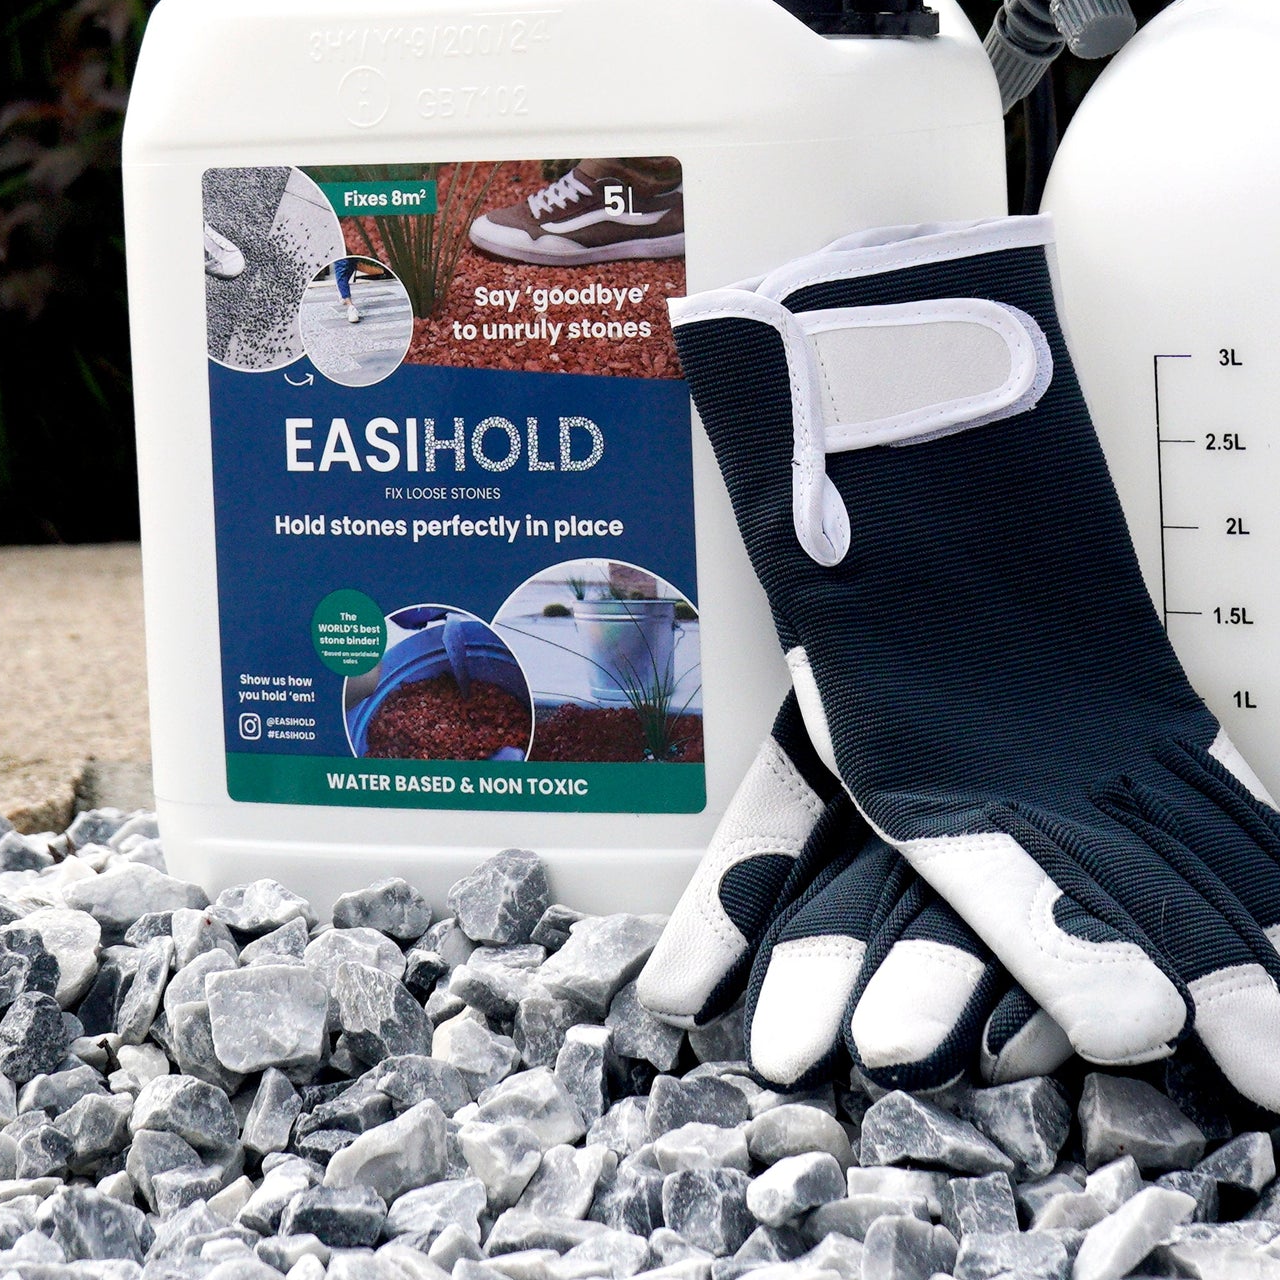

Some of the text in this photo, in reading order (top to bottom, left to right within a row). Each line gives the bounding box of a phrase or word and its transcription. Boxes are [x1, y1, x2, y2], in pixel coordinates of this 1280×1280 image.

[417, 85, 455, 118] GB
[344, 191, 388, 208] Fixes
[604, 185, 642, 217] 5L
[475, 286, 520, 312] Say
[452, 318, 652, 346] to unruly stones
[1219, 348, 1243, 366] 3L
[285, 416, 605, 473] EASIHOLD
[1205, 432, 1247, 452] 2.5L
[385, 487, 501, 500] FIX LOOSE STONES
[275, 514, 624, 543] Hold stones perfectly in place
[1226, 517, 1250, 535] 2L
[340, 612, 357, 621] The
[1213, 607, 1255, 626] 1.5L
[360, 624, 380, 634] best
[320, 636, 380, 646] stone binder!
[240, 674, 312, 687] Show us how
[239, 691, 260, 703] you
[261, 690, 287, 701] hold
[1233, 691, 1257, 709] 1L
[266, 717, 316, 727] @EASIHOLD
[267, 730, 316, 740] #EASIHOLD
[326, 773, 588, 795] WATER BASED & NON TOXIC
